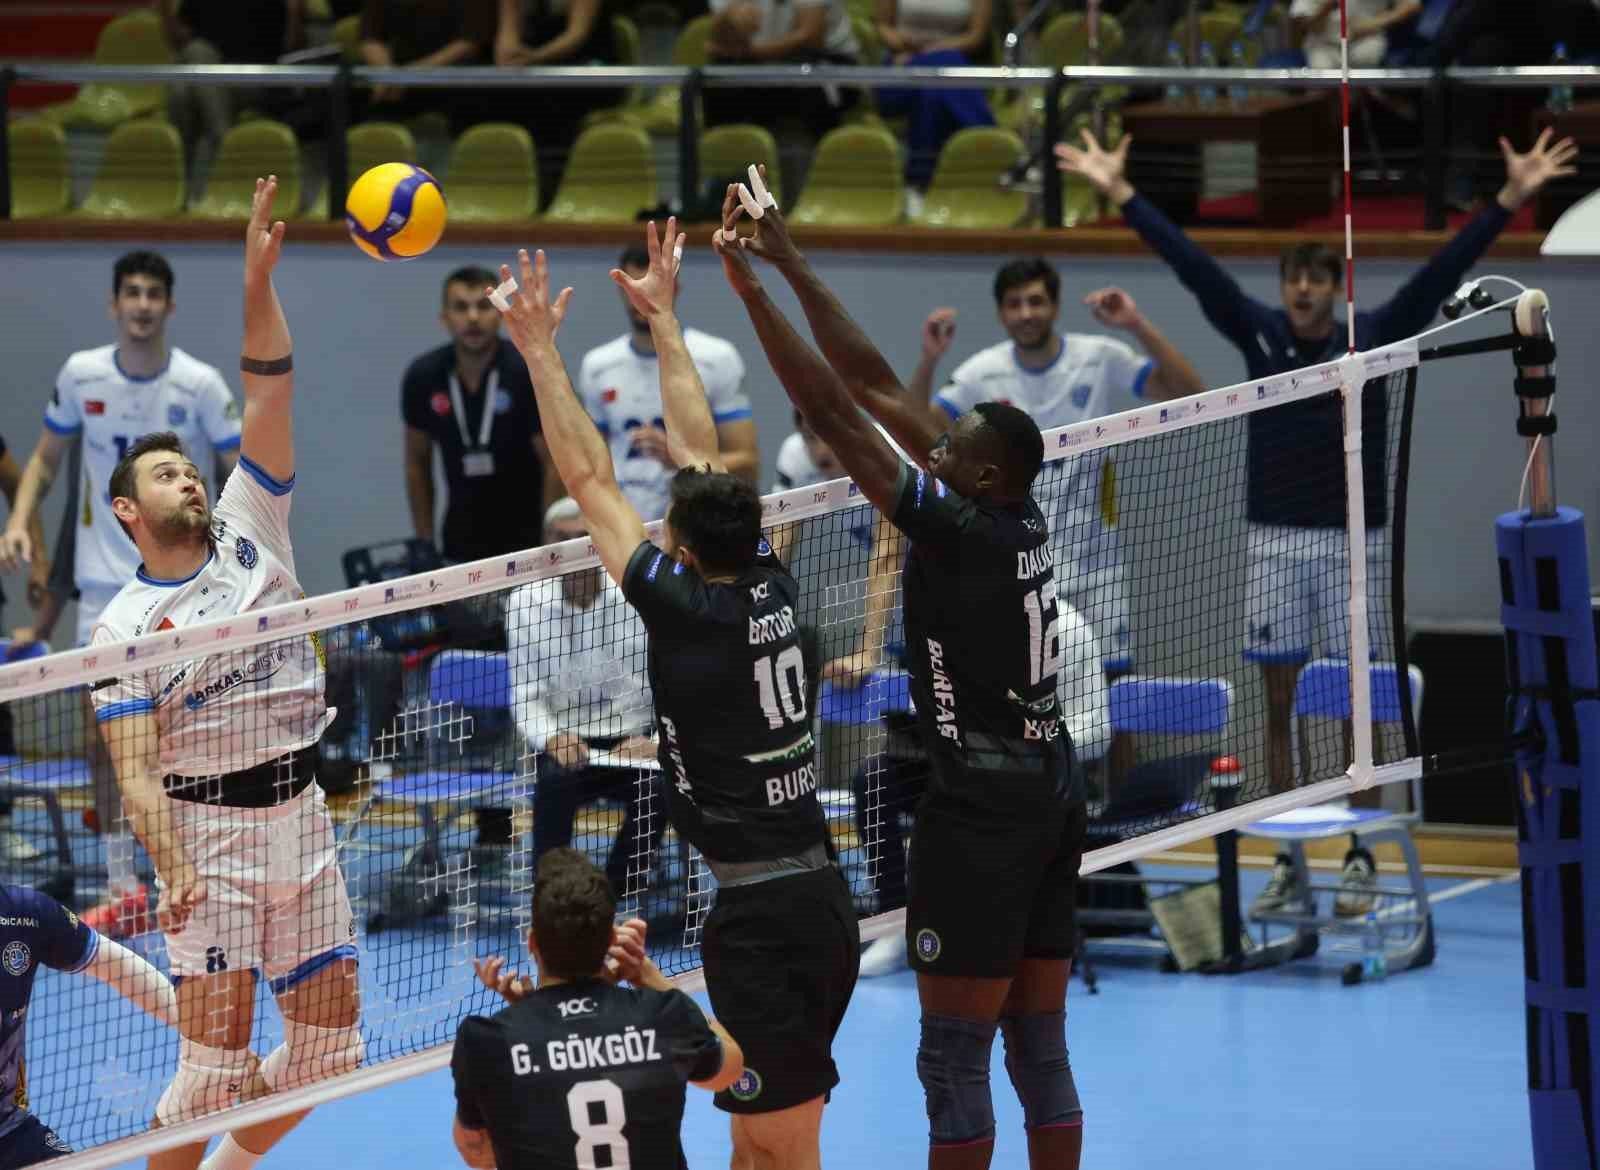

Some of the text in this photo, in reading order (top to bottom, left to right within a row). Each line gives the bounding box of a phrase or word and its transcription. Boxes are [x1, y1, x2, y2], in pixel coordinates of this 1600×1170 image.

[813, 491, 827, 504] TVF
[467, 570, 483, 585] TVF
[343, 598, 361, 613] TVF
[215, 626, 233, 640] TVF
[748, 605, 796, 645] BATUR
[195, 669, 243, 700] ARKAS
[753, 645, 808, 730] 10
[510, 1025, 662, 1076] G. GÖKGÖZ
[566, 1078, 632, 1170] 8
